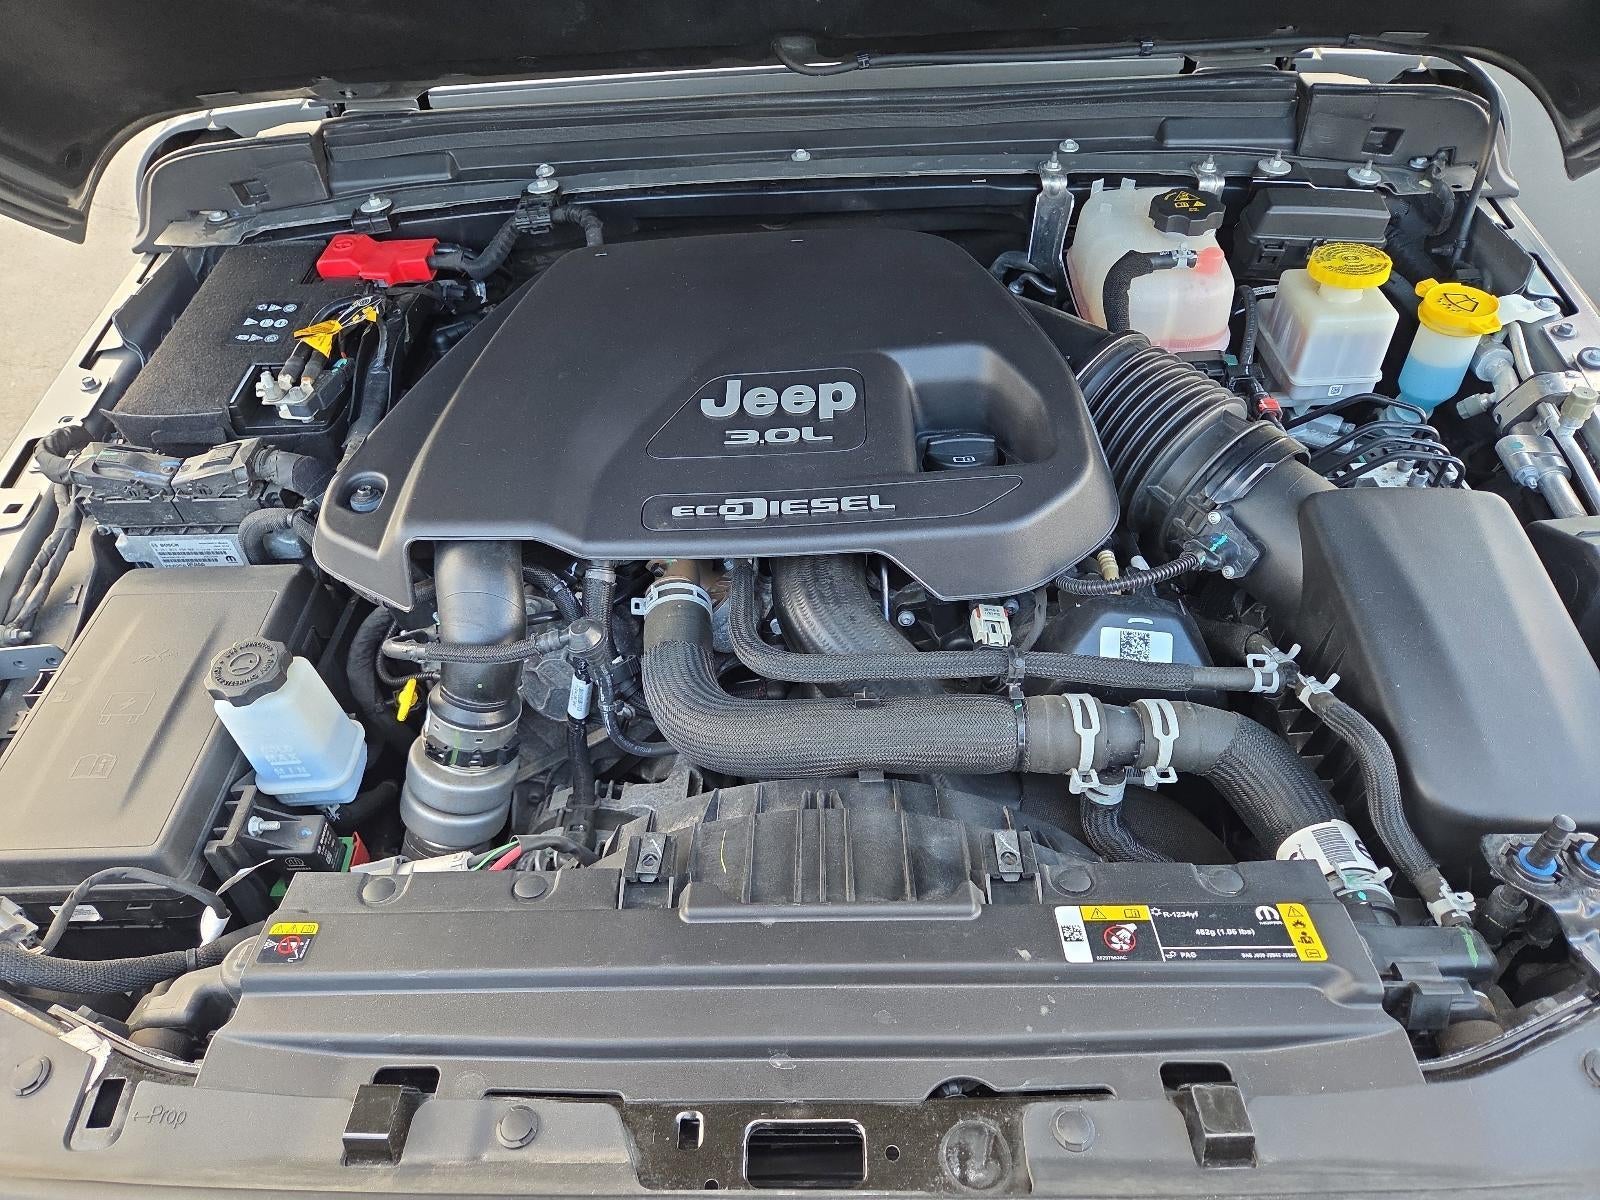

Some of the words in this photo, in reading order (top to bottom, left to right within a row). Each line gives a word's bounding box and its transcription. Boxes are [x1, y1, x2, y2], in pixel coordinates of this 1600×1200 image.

[701, 379, 857, 421] Jeep
[723, 425, 834, 446] 3.0L
[671, 494, 896, 521] ECODIESEL
[149, 1105, 187, 1129] Prop
